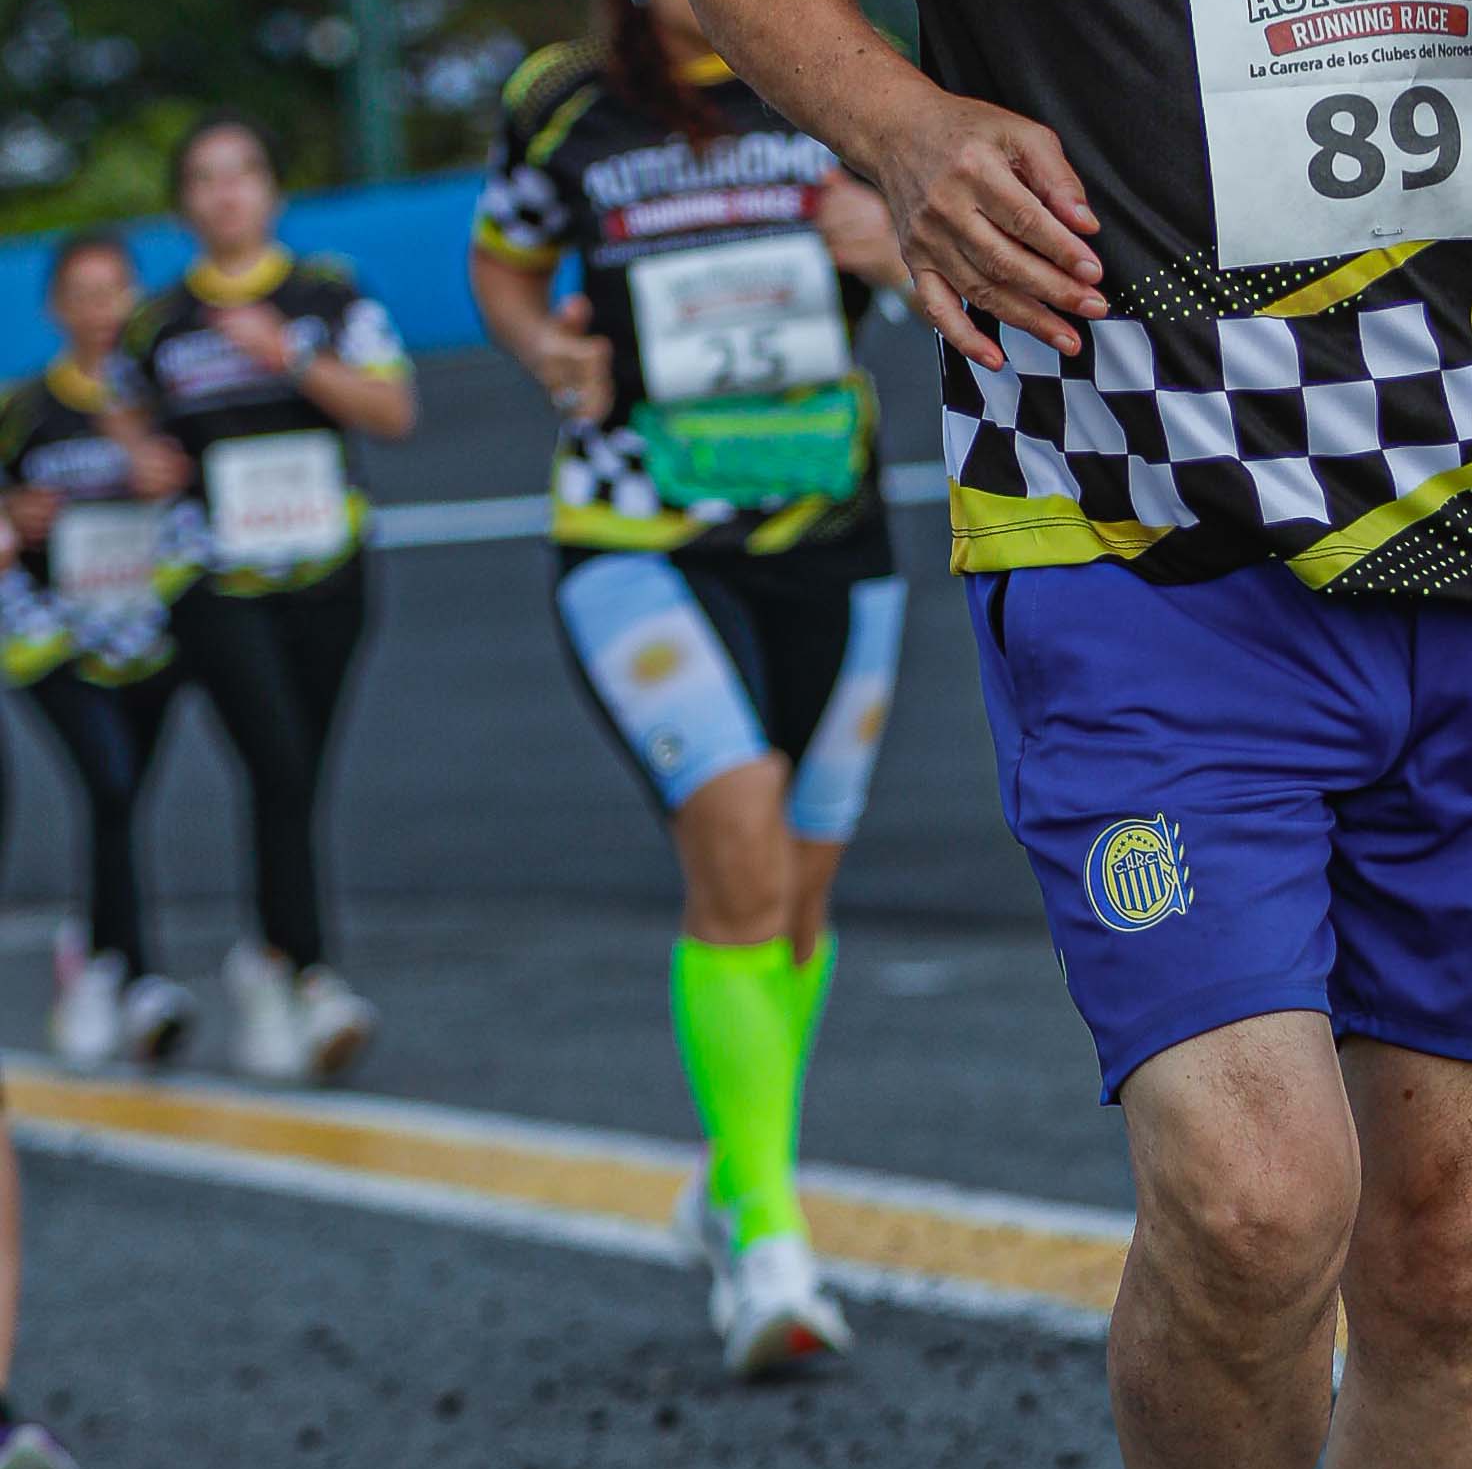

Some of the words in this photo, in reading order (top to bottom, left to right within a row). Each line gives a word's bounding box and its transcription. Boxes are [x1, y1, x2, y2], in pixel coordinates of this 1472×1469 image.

[1291, 5, 1393, 48] RUNNING
[1400, 5, 1449, 32] RACE
[1250, 63, 1266, 78] La
[1270, 60, 1323, 76] Carrera
[1327, 54, 1345, 68] de
[1349, 51, 1369, 66] los
[1372, 46, 1416, 63] Clubes
[1419, 43, 1436, 58] del
[1306, 85, 1462, 199] 89
[703, 328, 787, 391] 25
